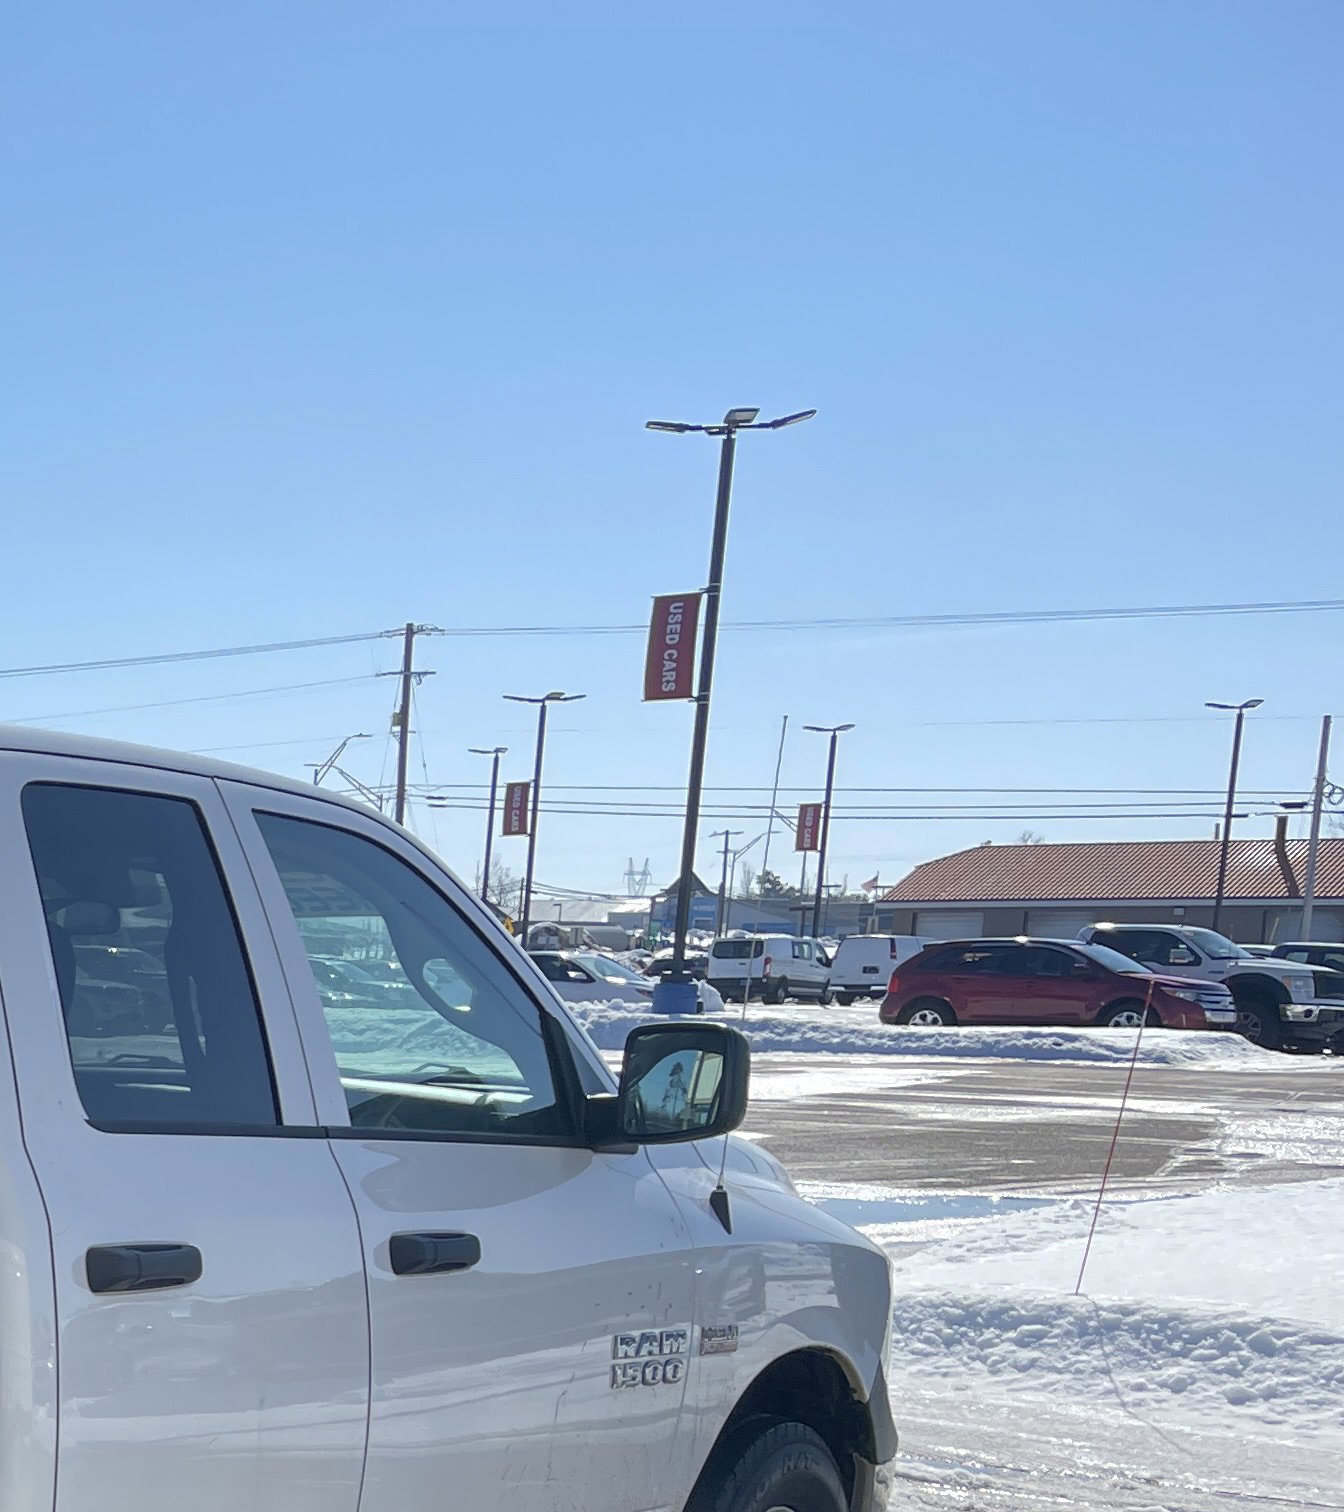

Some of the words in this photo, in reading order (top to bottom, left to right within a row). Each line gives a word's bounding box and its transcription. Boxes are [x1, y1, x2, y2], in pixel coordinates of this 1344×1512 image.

[665, 602, 684, 645] USED
[661, 648, 679, 692] CARS
[613, 1330, 688, 1360] RAM
[609, 1357, 685, 1390] 1500
